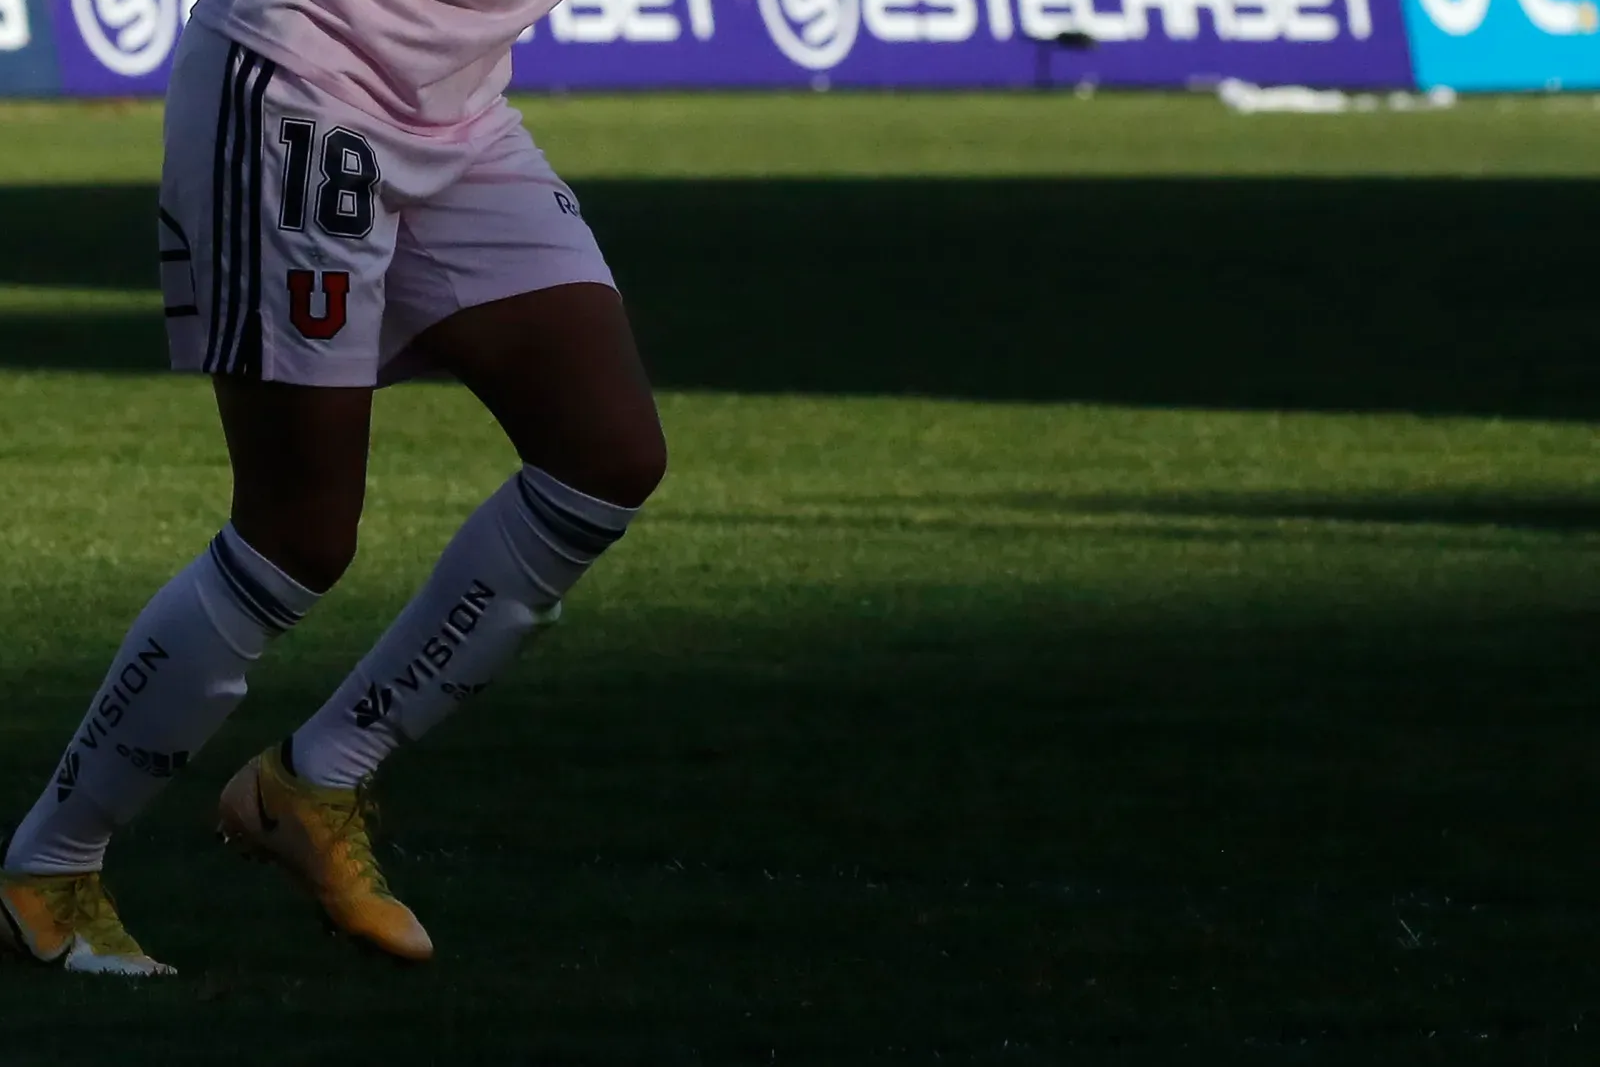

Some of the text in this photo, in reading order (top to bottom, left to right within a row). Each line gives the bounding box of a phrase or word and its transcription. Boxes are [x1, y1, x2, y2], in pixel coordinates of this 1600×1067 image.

[278, 117, 380, 239] 18
[287, 269, 349, 340] U
[393, 578, 496, 692] VISION
[79, 636, 170, 750] VISION
